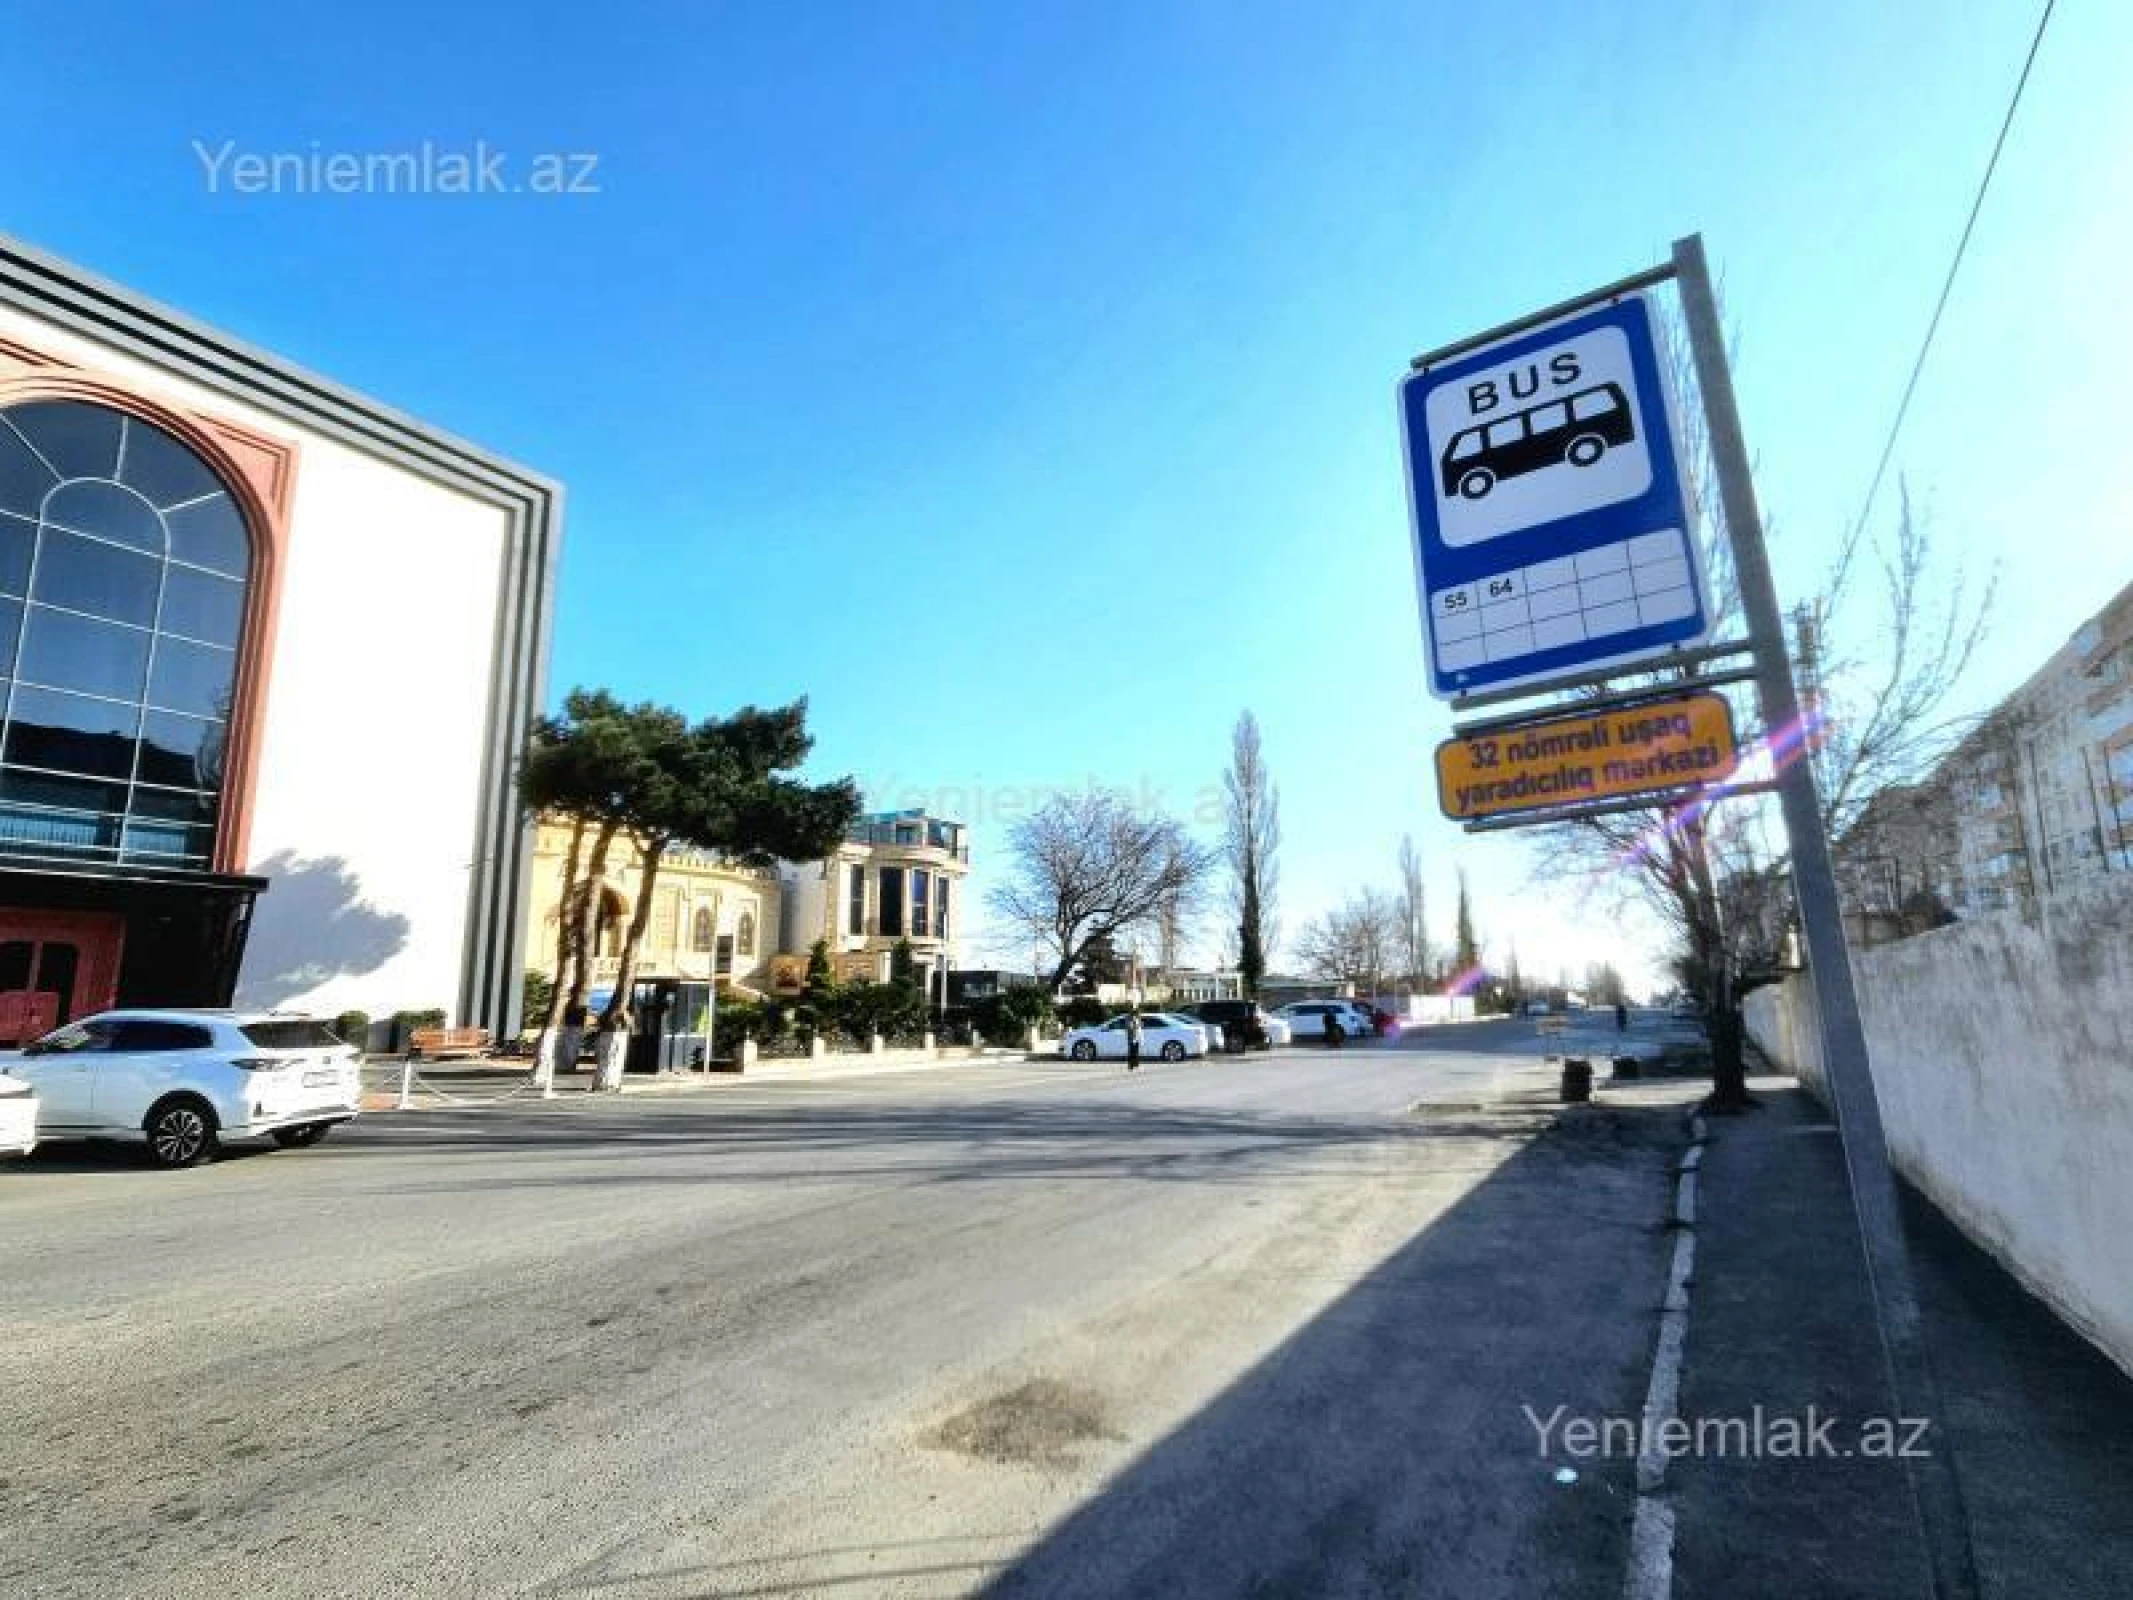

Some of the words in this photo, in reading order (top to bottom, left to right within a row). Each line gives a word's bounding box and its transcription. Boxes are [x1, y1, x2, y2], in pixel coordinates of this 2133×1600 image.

[1468, 352, 1581, 416] BUS
[1445, 592, 1467, 609] 55
[1489, 578, 1512, 598] 64
[1469, 742, 1498, 768] 32
